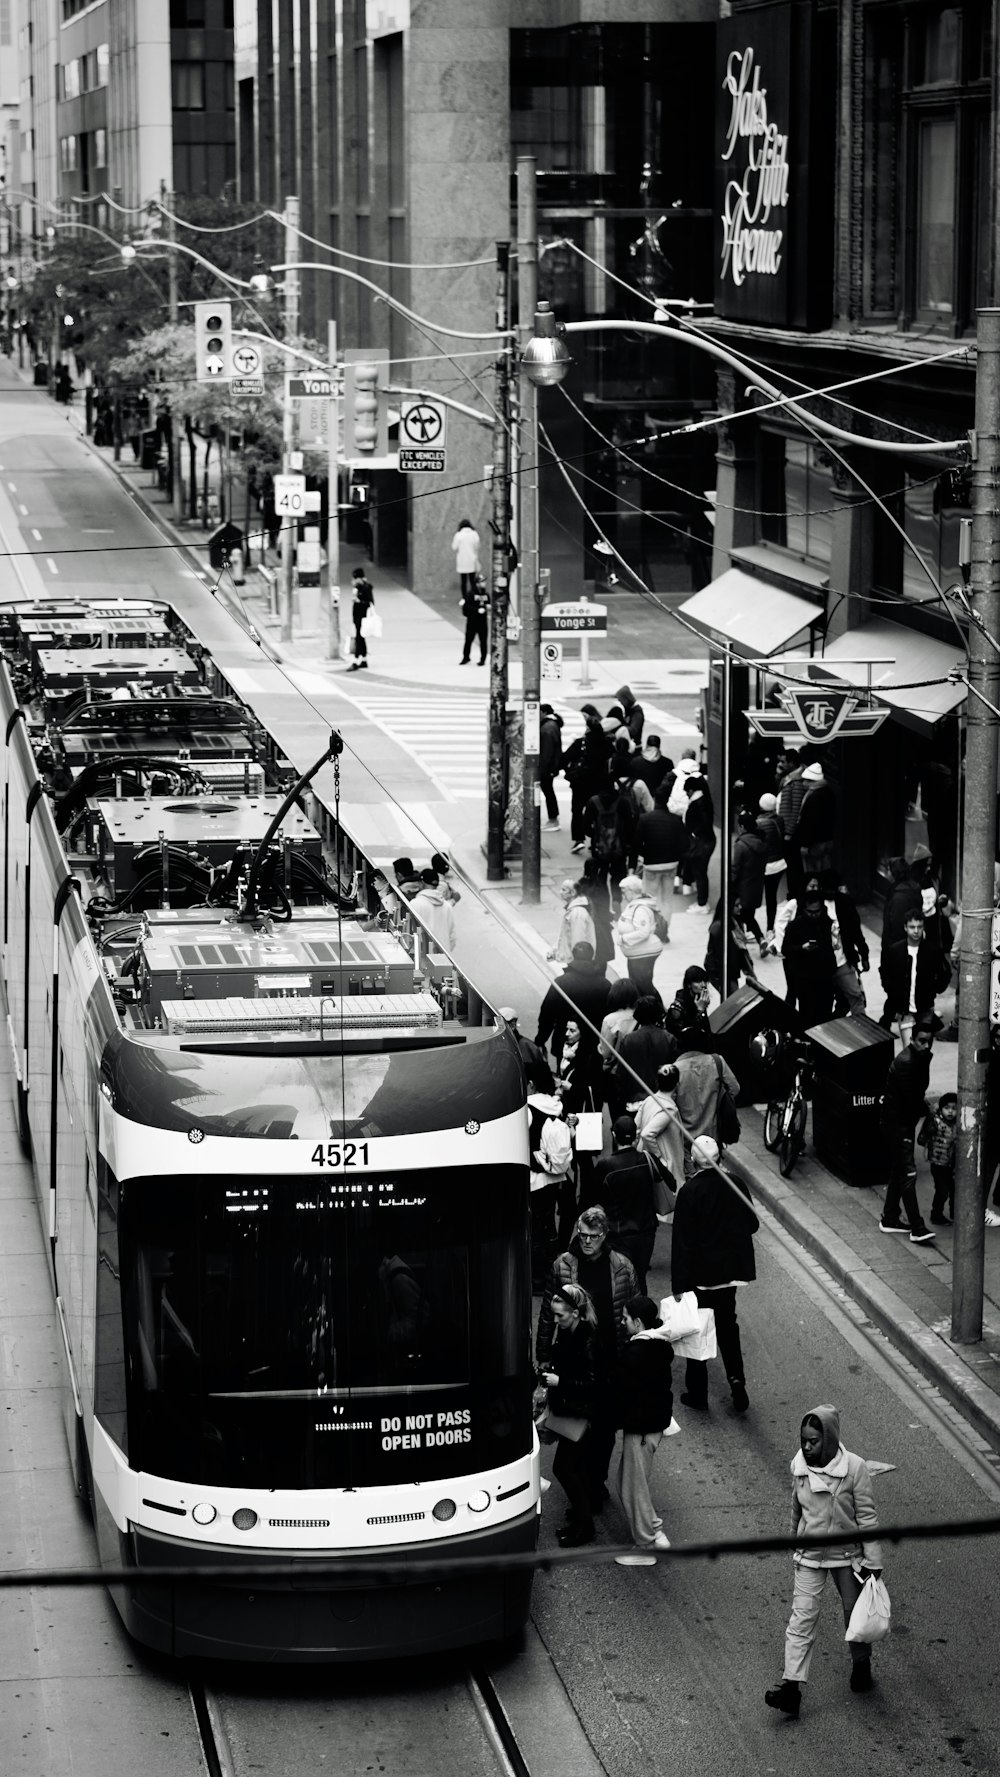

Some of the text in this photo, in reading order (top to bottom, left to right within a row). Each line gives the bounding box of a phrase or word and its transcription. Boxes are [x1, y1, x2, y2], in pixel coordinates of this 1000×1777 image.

[720, 181, 784, 287] Avenue
[400, 451, 445, 460] TTC VEHICLES
[401, 461, 443, 470] EXCEPTED
[280, 494, 302, 510] 40
[554, 617, 585, 630] Yonge
[853, 1095, 875, 1107] Litter
[311, 1143, 369, 1167] 4521
[380, 1409, 471, 1432] DO NOT PASS
[382, 1428, 472, 1451] OPEN DOORS
